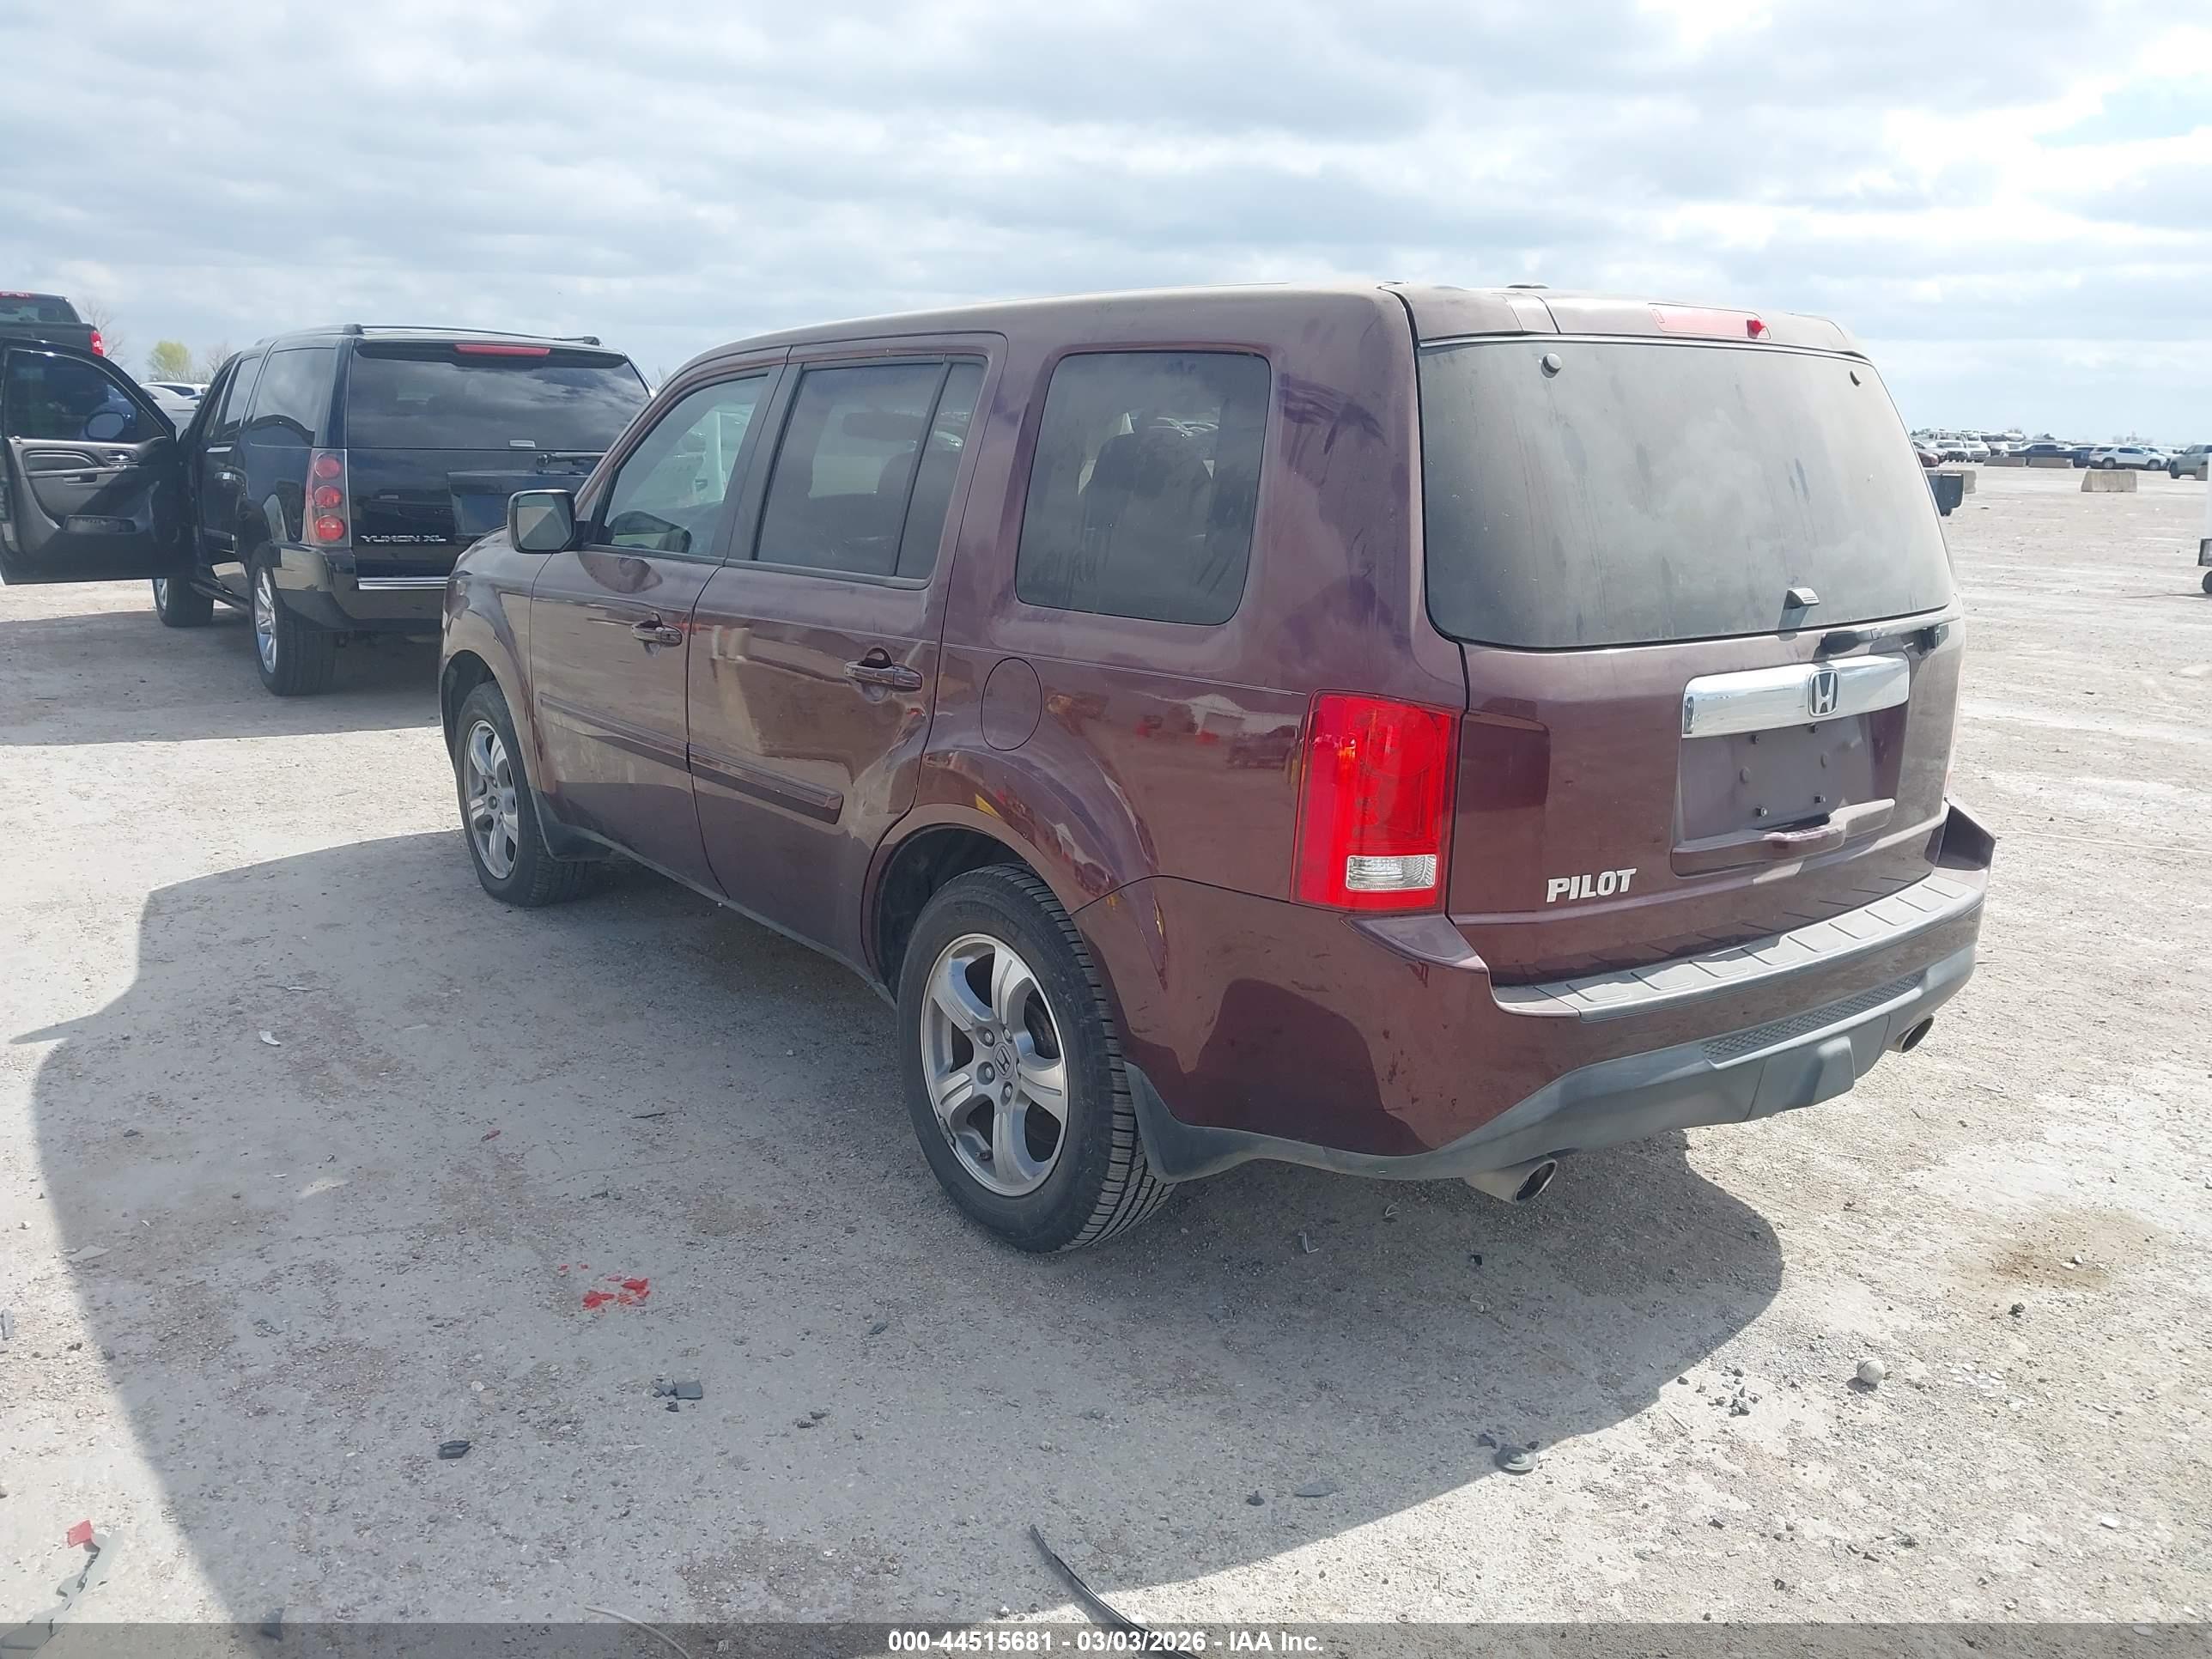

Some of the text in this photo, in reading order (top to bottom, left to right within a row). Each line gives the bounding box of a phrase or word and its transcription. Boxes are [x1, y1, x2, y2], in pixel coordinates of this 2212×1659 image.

[360, 534, 447, 543] YUKON XL
[1546, 867, 1638, 903] PILOT
